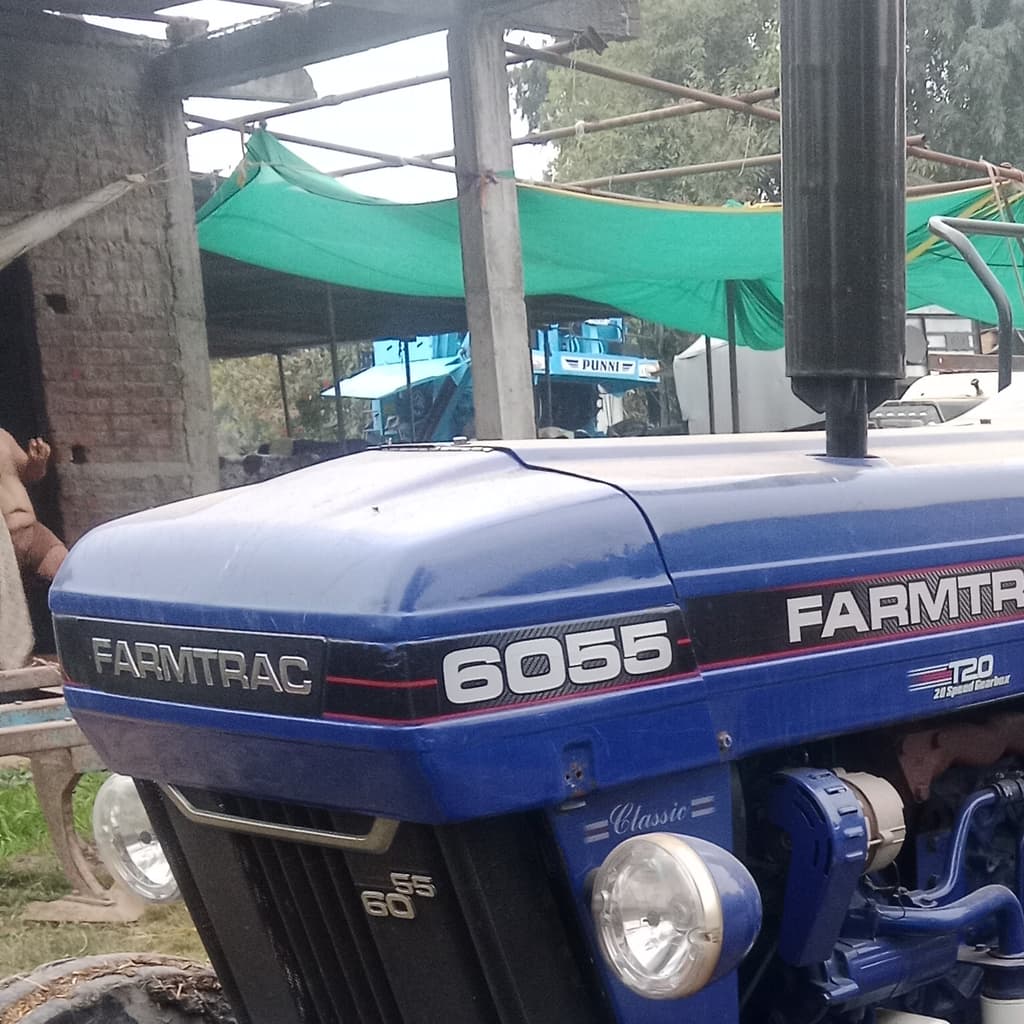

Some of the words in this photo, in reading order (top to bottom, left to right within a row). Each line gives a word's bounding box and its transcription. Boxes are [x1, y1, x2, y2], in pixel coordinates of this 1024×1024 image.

[582, 359, 620, 373] PUNNI
[91, 637, 312, 695] FARMTRAC
[442, 619, 673, 704] 6055
[948, 654, 994, 684] T20
[933, 687, 945, 700] 20
[946, 681, 974, 698] Speed
[609, 802, 687, 835] Classic
